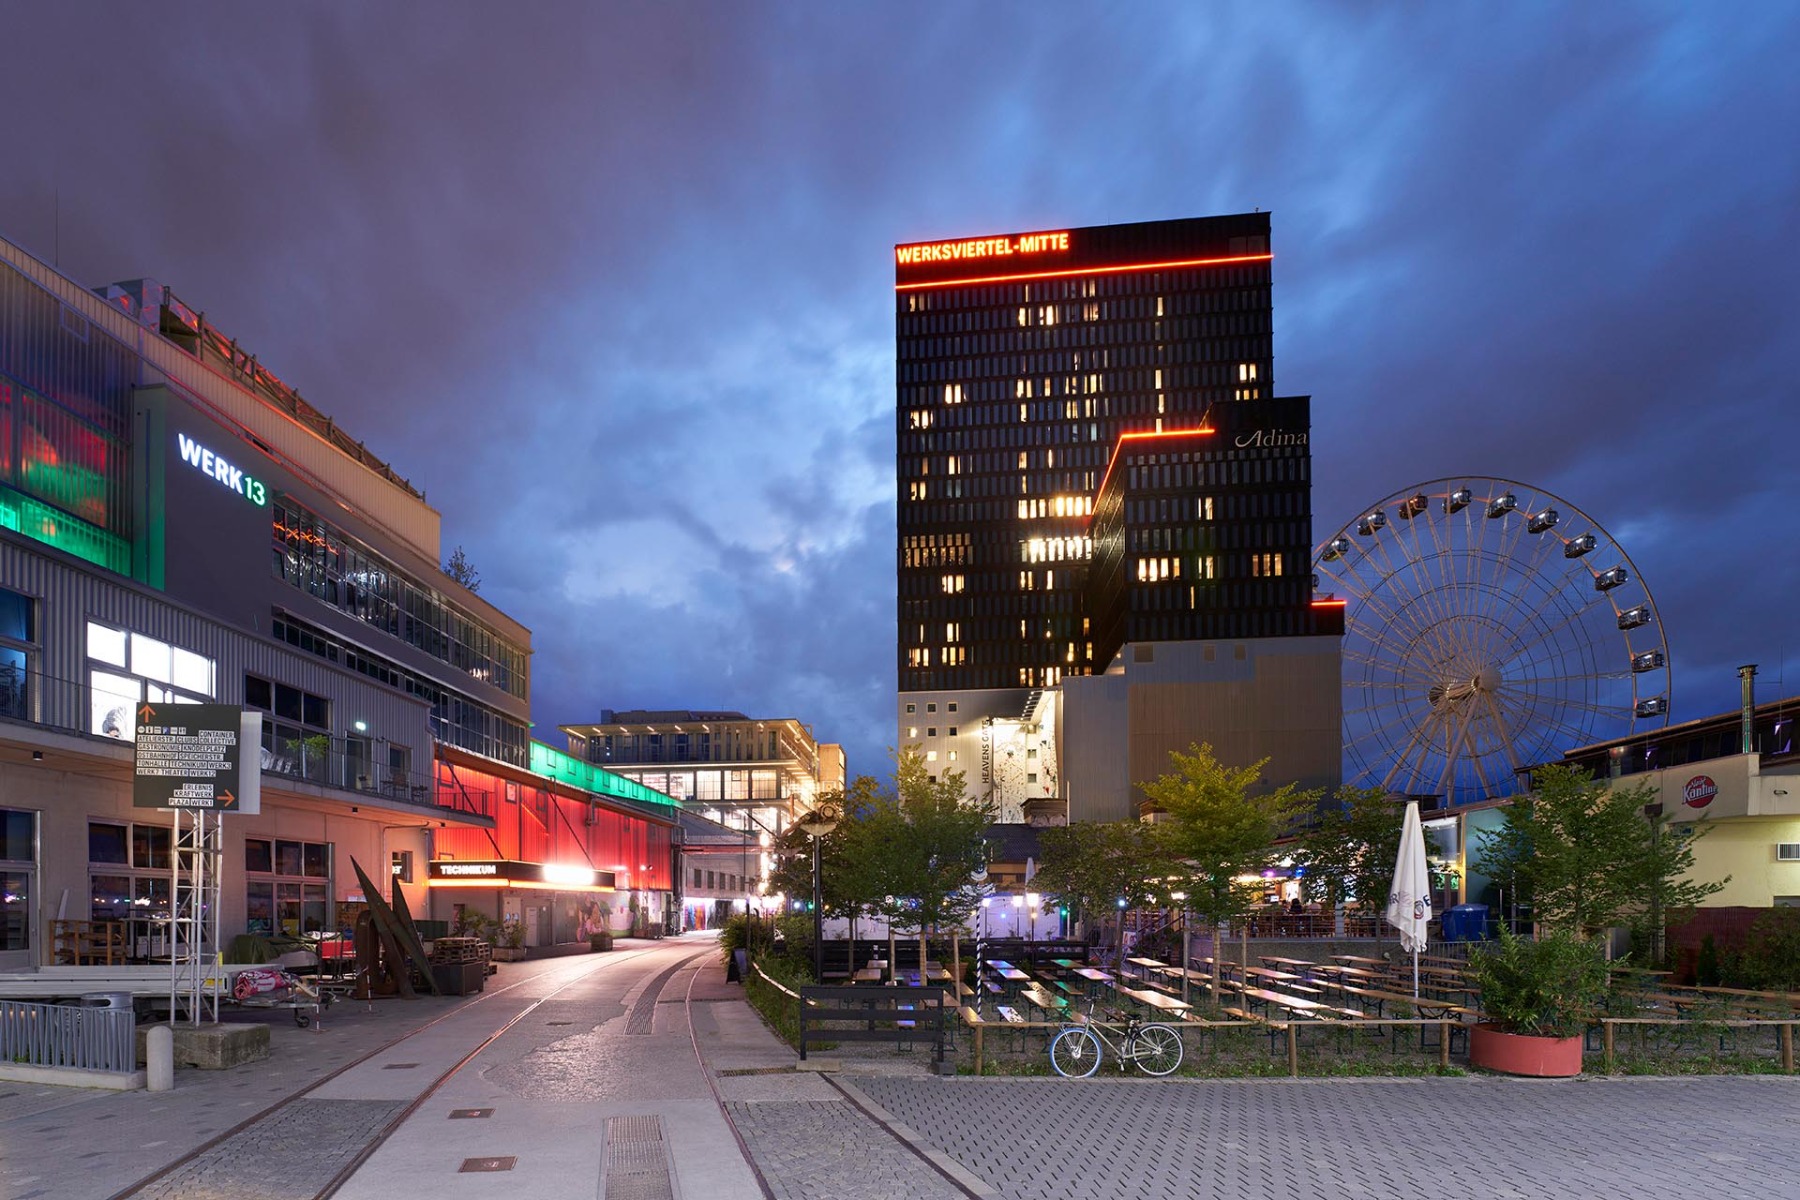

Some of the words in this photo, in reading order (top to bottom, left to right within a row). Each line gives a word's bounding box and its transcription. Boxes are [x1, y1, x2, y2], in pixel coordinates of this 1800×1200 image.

[896, 233, 1069, 264] WERKSVIERTEL-MITTE
[1234, 428, 1307, 448] Adina
[138, 743, 181, 751] GASTRONOMIE
[138, 751, 178, 759] OSTBAHNHOF
[981, 743, 990, 784] HEAVENS
[174, 790, 213, 798] KRAFTWERK
[1682, 784, 1718, 804] Kantine
[440, 864, 496, 875] TECHNIKUM
